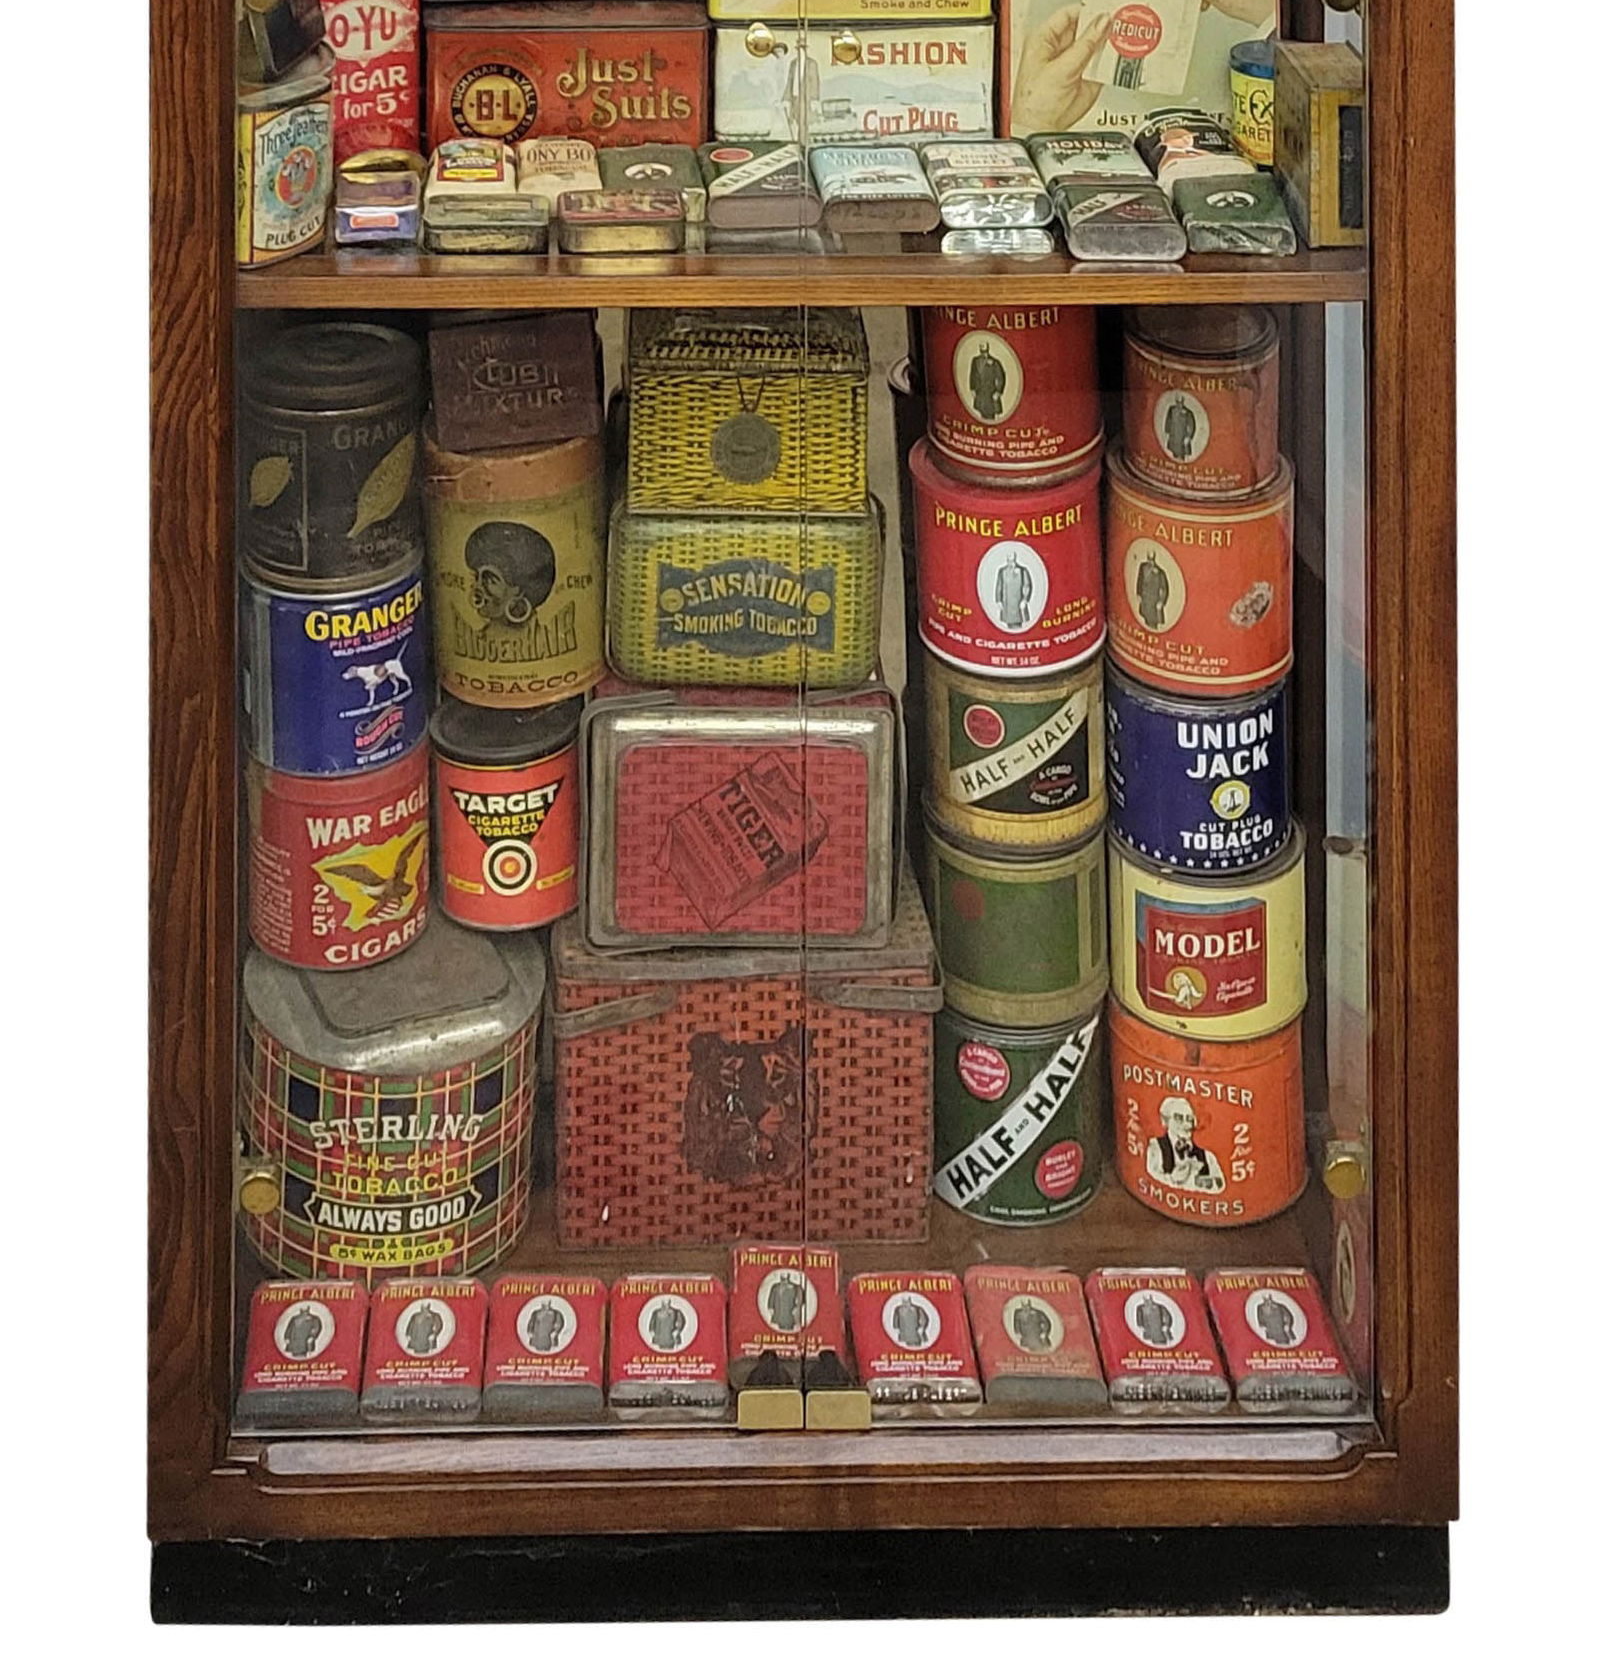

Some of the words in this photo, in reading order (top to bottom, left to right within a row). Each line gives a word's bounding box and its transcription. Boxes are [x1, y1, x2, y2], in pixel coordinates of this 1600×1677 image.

[861, 0, 907, 10] Smoke
[1113, 19, 1161, 40] REDICUT
[555, 47, 657, 98] Just
[343, 100, 374, 119] for
[590, 85, 693, 128] Suits
[863, 110, 904, 136] CUT
[907, 107, 959, 133] PLUG
[1097, 110, 1137, 127] JUST
[258, 127, 293, 166] Three
[1047, 140, 1127, 150] HOLIDAY
[264, 230, 298, 248] PLUG
[300, 215, 321, 236] CUT
[987, 307, 1061, 330] ALBERT
[953, 431, 1005, 449] BURNING
[1008, 440, 1035, 449] PIPE
[1038, 435, 1064, 448] AND
[1005, 425, 1044, 438] CUT
[999, 446, 1058, 458] TOBACCO
[934, 502, 1004, 537] PRINCE
[1013, 503, 1083, 537] ALBERT
[1155, 522, 1234, 547] ALBERT
[681, 572, 807, 607] SENSATION
[304, 580, 424, 642] GRANGER
[673, 608, 744, 636] SMOKING
[750, 608, 817, 636] TOBACCO
[329, 636, 363, 650] PIPE
[947, 630, 972, 644] AND
[975, 637, 1051, 650] CIGARETTE
[1166, 640, 1206, 656] CUT
[1159, 659, 1221, 675] TOBACCO
[1167, 652, 1196, 665] PIPE
[1199, 657, 1229, 667] AND
[454, 671, 578, 695] TOBACCO
[1177, 708, 1274, 750] UNION
[959, 755, 1011, 795] HALF
[1026, 707, 1077, 760] HALF
[1185, 740, 1270, 780] JACK
[453, 783, 558, 814] TARGET
[468, 809, 545, 826] CIGARETTE
[719, 779, 786, 871] TIGER
[1199, 822, 1226, 833] CUT
[305, 814, 373, 850] WAR
[476, 822, 539, 837] TOBACCO
[1179, 817, 1274, 851] TOBACCO
[312, 884, 330, 904] 2
[311, 905, 335, 914] FOR
[323, 906, 427, 964] CIGARS
[1154, 926, 1262, 959] MODEL
[1122, 1063, 1254, 1109] POSTMASTER
[308, 1113, 486, 1150] STERLING
[1232, 1123, 1249, 1145] 2
[345, 1153, 395, 1172] FINE
[407, 1151, 449, 1170] CUT
[946, 1124, 1017, 1201] HALF
[1014, 1117, 1030, 1136] AND
[331, 1168, 460, 1197] TOBACCO
[1137, 1177, 1245, 1216] SMOKERS
[317, 1199, 403, 1233] ALWAYS
[409, 1195, 467, 1229] GOOD
[361, 1250, 398, 1262] WAX
[403, 1243, 447, 1260] BAGS
[740, 1251, 785, 1267] PRINCE
[261, 1287, 307, 1302] PRINCE
[310, 1286, 356, 1301] ALBERT
[380, 1286, 426, 1302] PRINCE
[431, 1285, 476, 1299] ALBERT
[502, 1282, 547, 1297] PRINCE
[551, 1282, 596, 1297] ALBERT
[620, 1280, 665, 1295] PRINCE
[669, 1280, 715, 1295] ALBERT
[858, 1277, 903, 1293] PRINCE
[907, 1278, 953, 1293] ALBERT
[977, 1276, 1021, 1292] PRINCE
[1025, 1278, 1072, 1294] ALBERT
[1098, 1277, 1144, 1294] PRINCE
[1147, 1277, 1193, 1292] ALBERT
[1215, 1276, 1262, 1293] PRINCE
[1265, 1276, 1312, 1291] ALBERT
